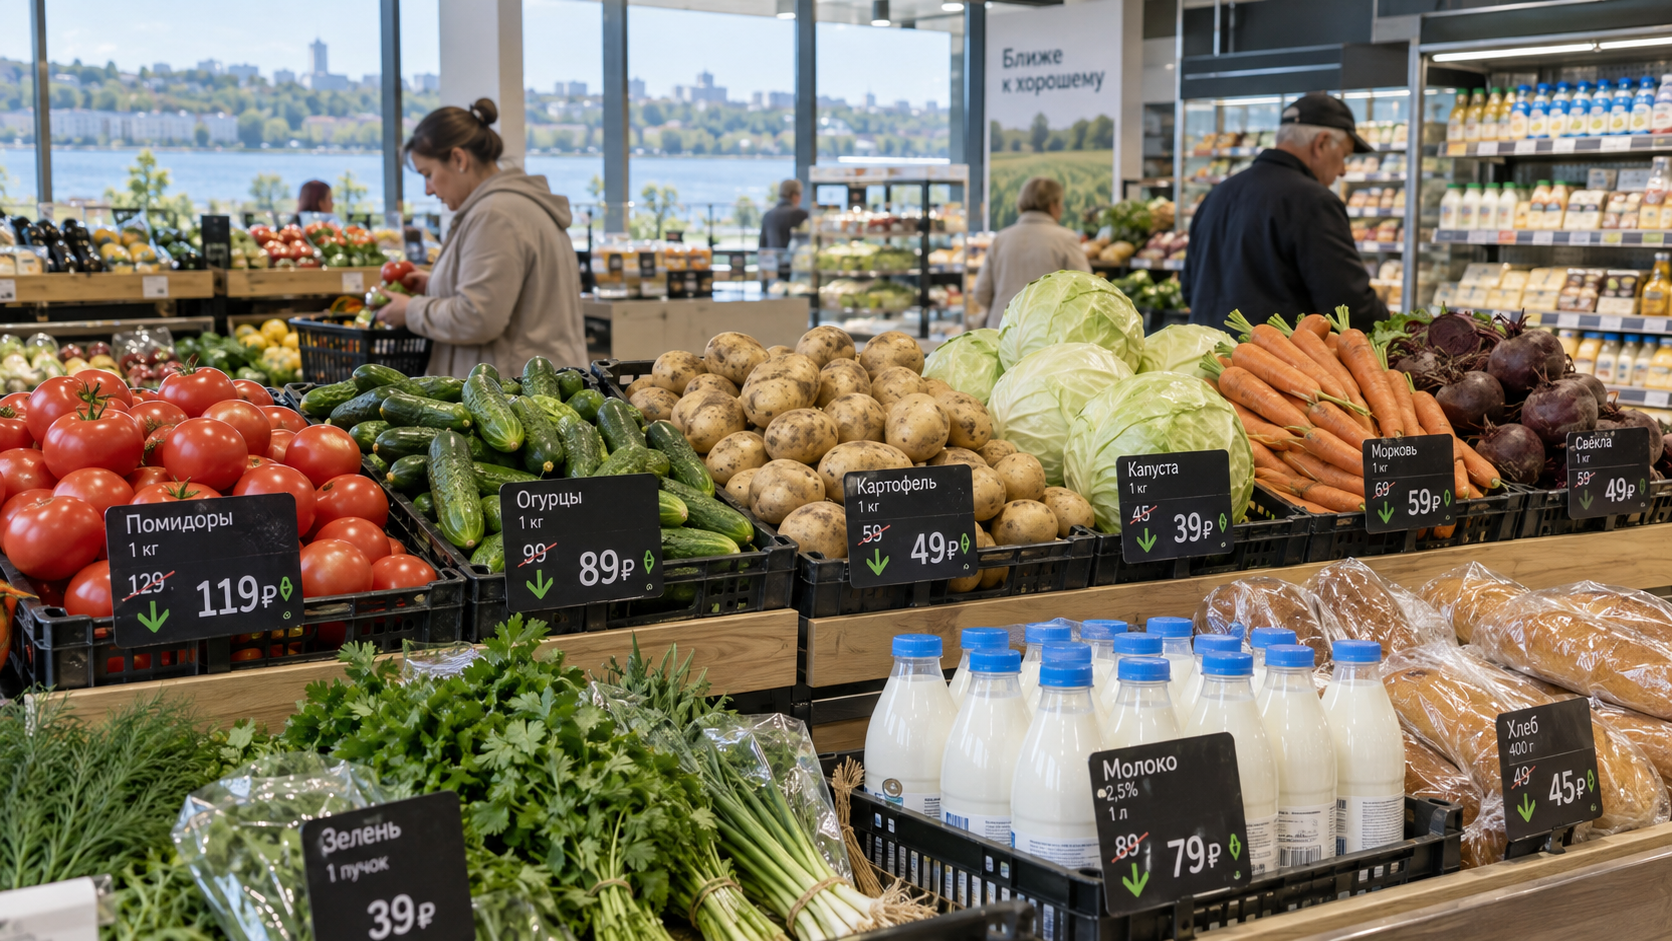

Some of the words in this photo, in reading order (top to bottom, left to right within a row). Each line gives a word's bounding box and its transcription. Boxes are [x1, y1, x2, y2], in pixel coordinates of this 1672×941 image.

[1002, 48, 1063, 69] Ближе
[1002, 78, 1012, 93] к
[1015, 70, 1106, 96] хорошему
[1372, 444, 1418, 460] Морковь
[1576, 436, 1612, 450] Свёкла
[1372, 462, 1377, 474] 1
[1380, 464, 1388, 472] кг
[1576, 454, 1580, 464] 1
[1582, 455, 1590, 463] кг
[1128, 461, 1179, 480] Капуста
[1577, 471, 1590, 486] 59
[856, 474, 937, 497] Картофель
[1129, 482, 1134, 494] 1
[1137, 484, 1148, 494] кг
[1375, 481, 1390, 497] 69
[1604, 477, 1636, 502] 49₽
[516, 490, 582, 512] Огурцы
[858, 500, 864, 512] 1
[868, 502, 880, 512] кг
[1408, 488, 1441, 516] 59₽
[126, 512, 233, 534] Помидоры
[518, 516, 525, 530] 1
[530, 518, 544, 528] кг
[1132, 505, 1150, 522] 45
[862, 524, 882, 544] 59
[1174, 512, 1213, 544] 39₽
[128, 542, 136, 558] 1
[142, 544, 158, 556] кг
[523, 542, 547, 564] 99
[910, 532, 959, 565] 49₽
[579, 549, 635, 587] 89₽
[128, 572, 165, 596] 129
[196, 575, 278, 618] 119₽
[1507, 716, 1538, 739] Хлеб
[1508, 740, 1528, 757] 400
[1529, 742, 1534, 752] г
[1103, 755, 1178, 782] Молоко
[1514, 766, 1530, 787] 49
[1105, 781, 1138, 802] 2,5%
[1548, 770, 1586, 806] 45₽
[1108, 806, 1116, 822] 1
[1119, 808, 1128, 820] л
[321, 820, 402, 854] Зелень
[1115, 833, 1140, 860] 89
[1167, 835, 1222, 878] 79₽
[326, 863, 336, 884] 1
[340, 856, 390, 883] пучок
[367, 894, 436, 941] 39₽
